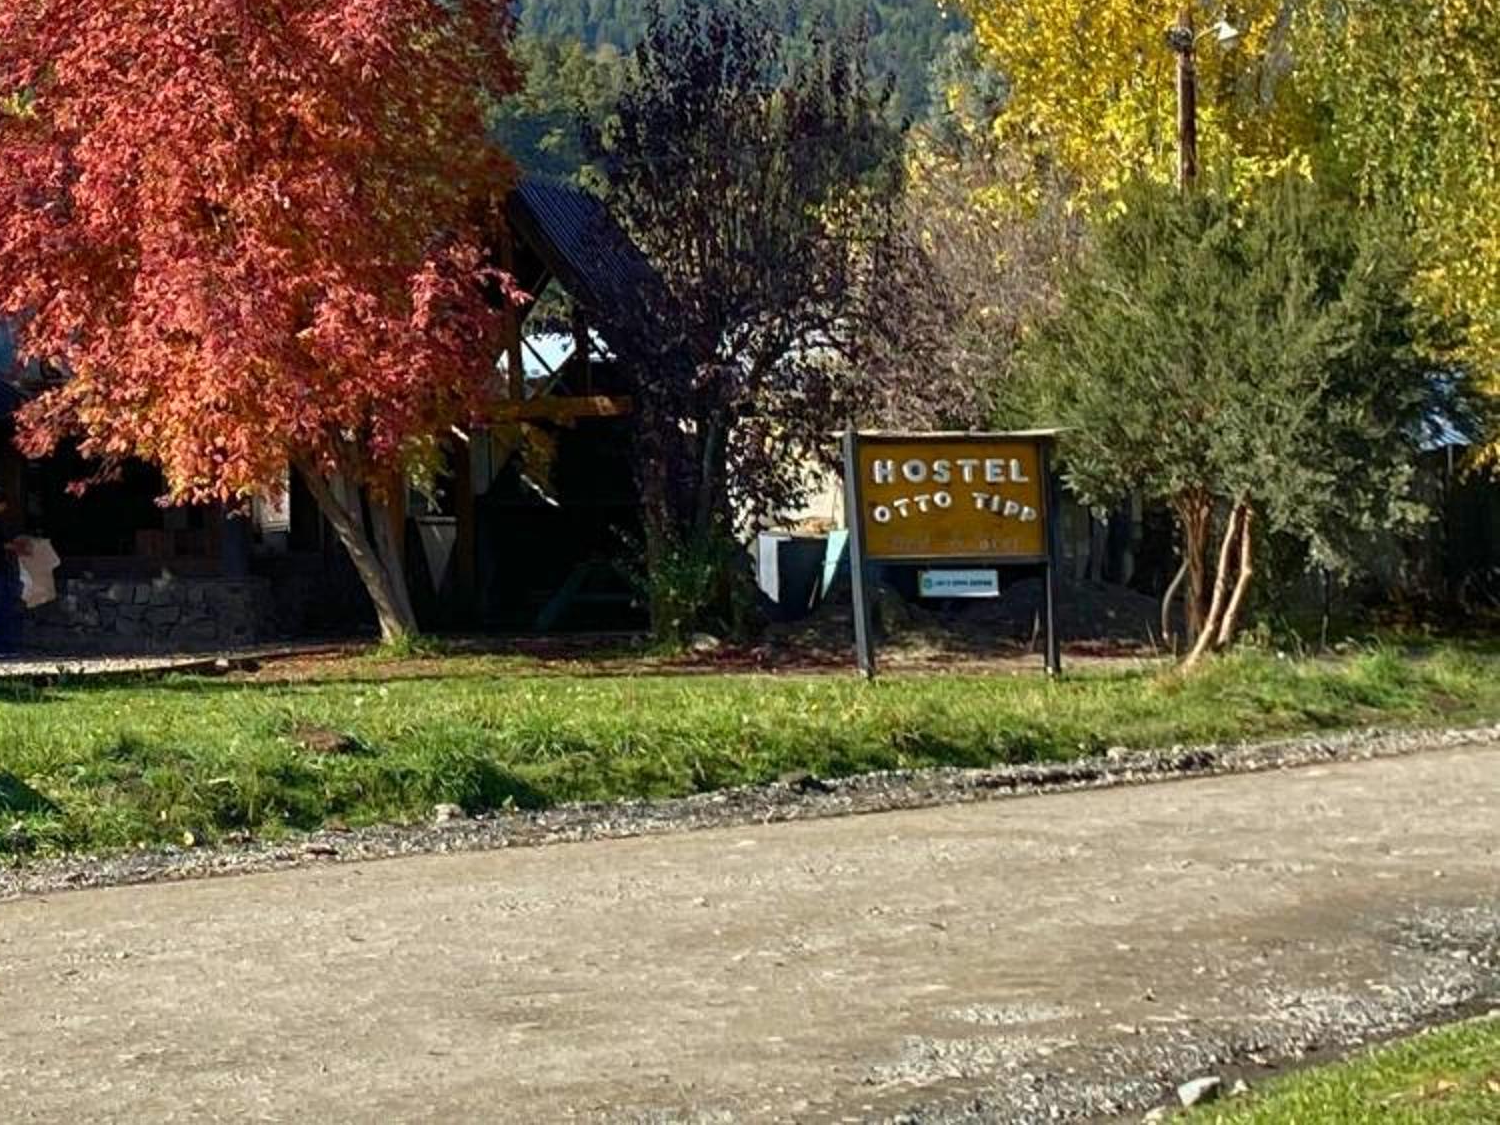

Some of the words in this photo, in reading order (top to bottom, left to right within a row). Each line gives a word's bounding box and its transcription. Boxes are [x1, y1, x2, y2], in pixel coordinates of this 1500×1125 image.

[873, 459, 1029, 484] HOSTEL
[873, 491, 952, 523] OTTO
[972, 492, 1037, 522] TIPP
